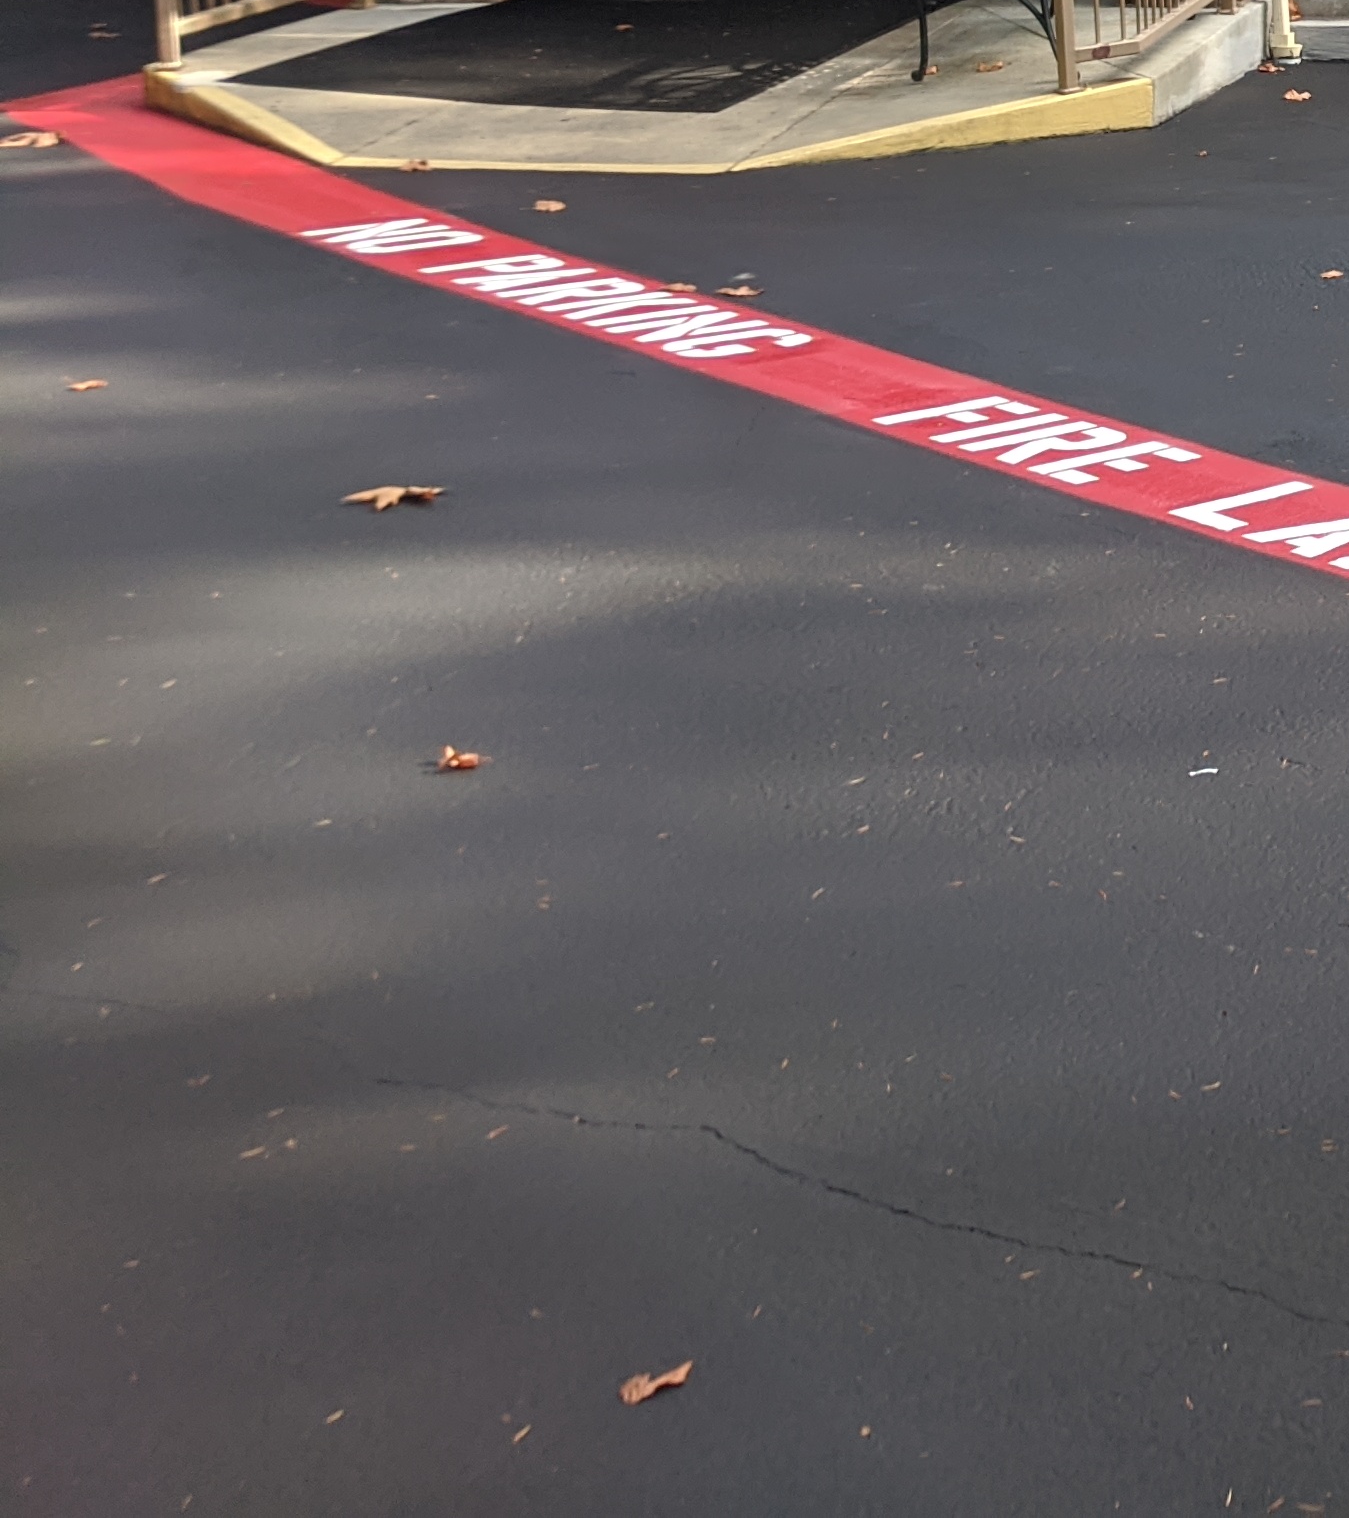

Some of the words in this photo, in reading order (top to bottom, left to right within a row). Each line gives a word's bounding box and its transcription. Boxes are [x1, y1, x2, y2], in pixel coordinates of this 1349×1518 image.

[298, 218, 484, 254] NO
[417, 254, 813, 358] PARKING
[871, 396, 1203, 485] FIRE
